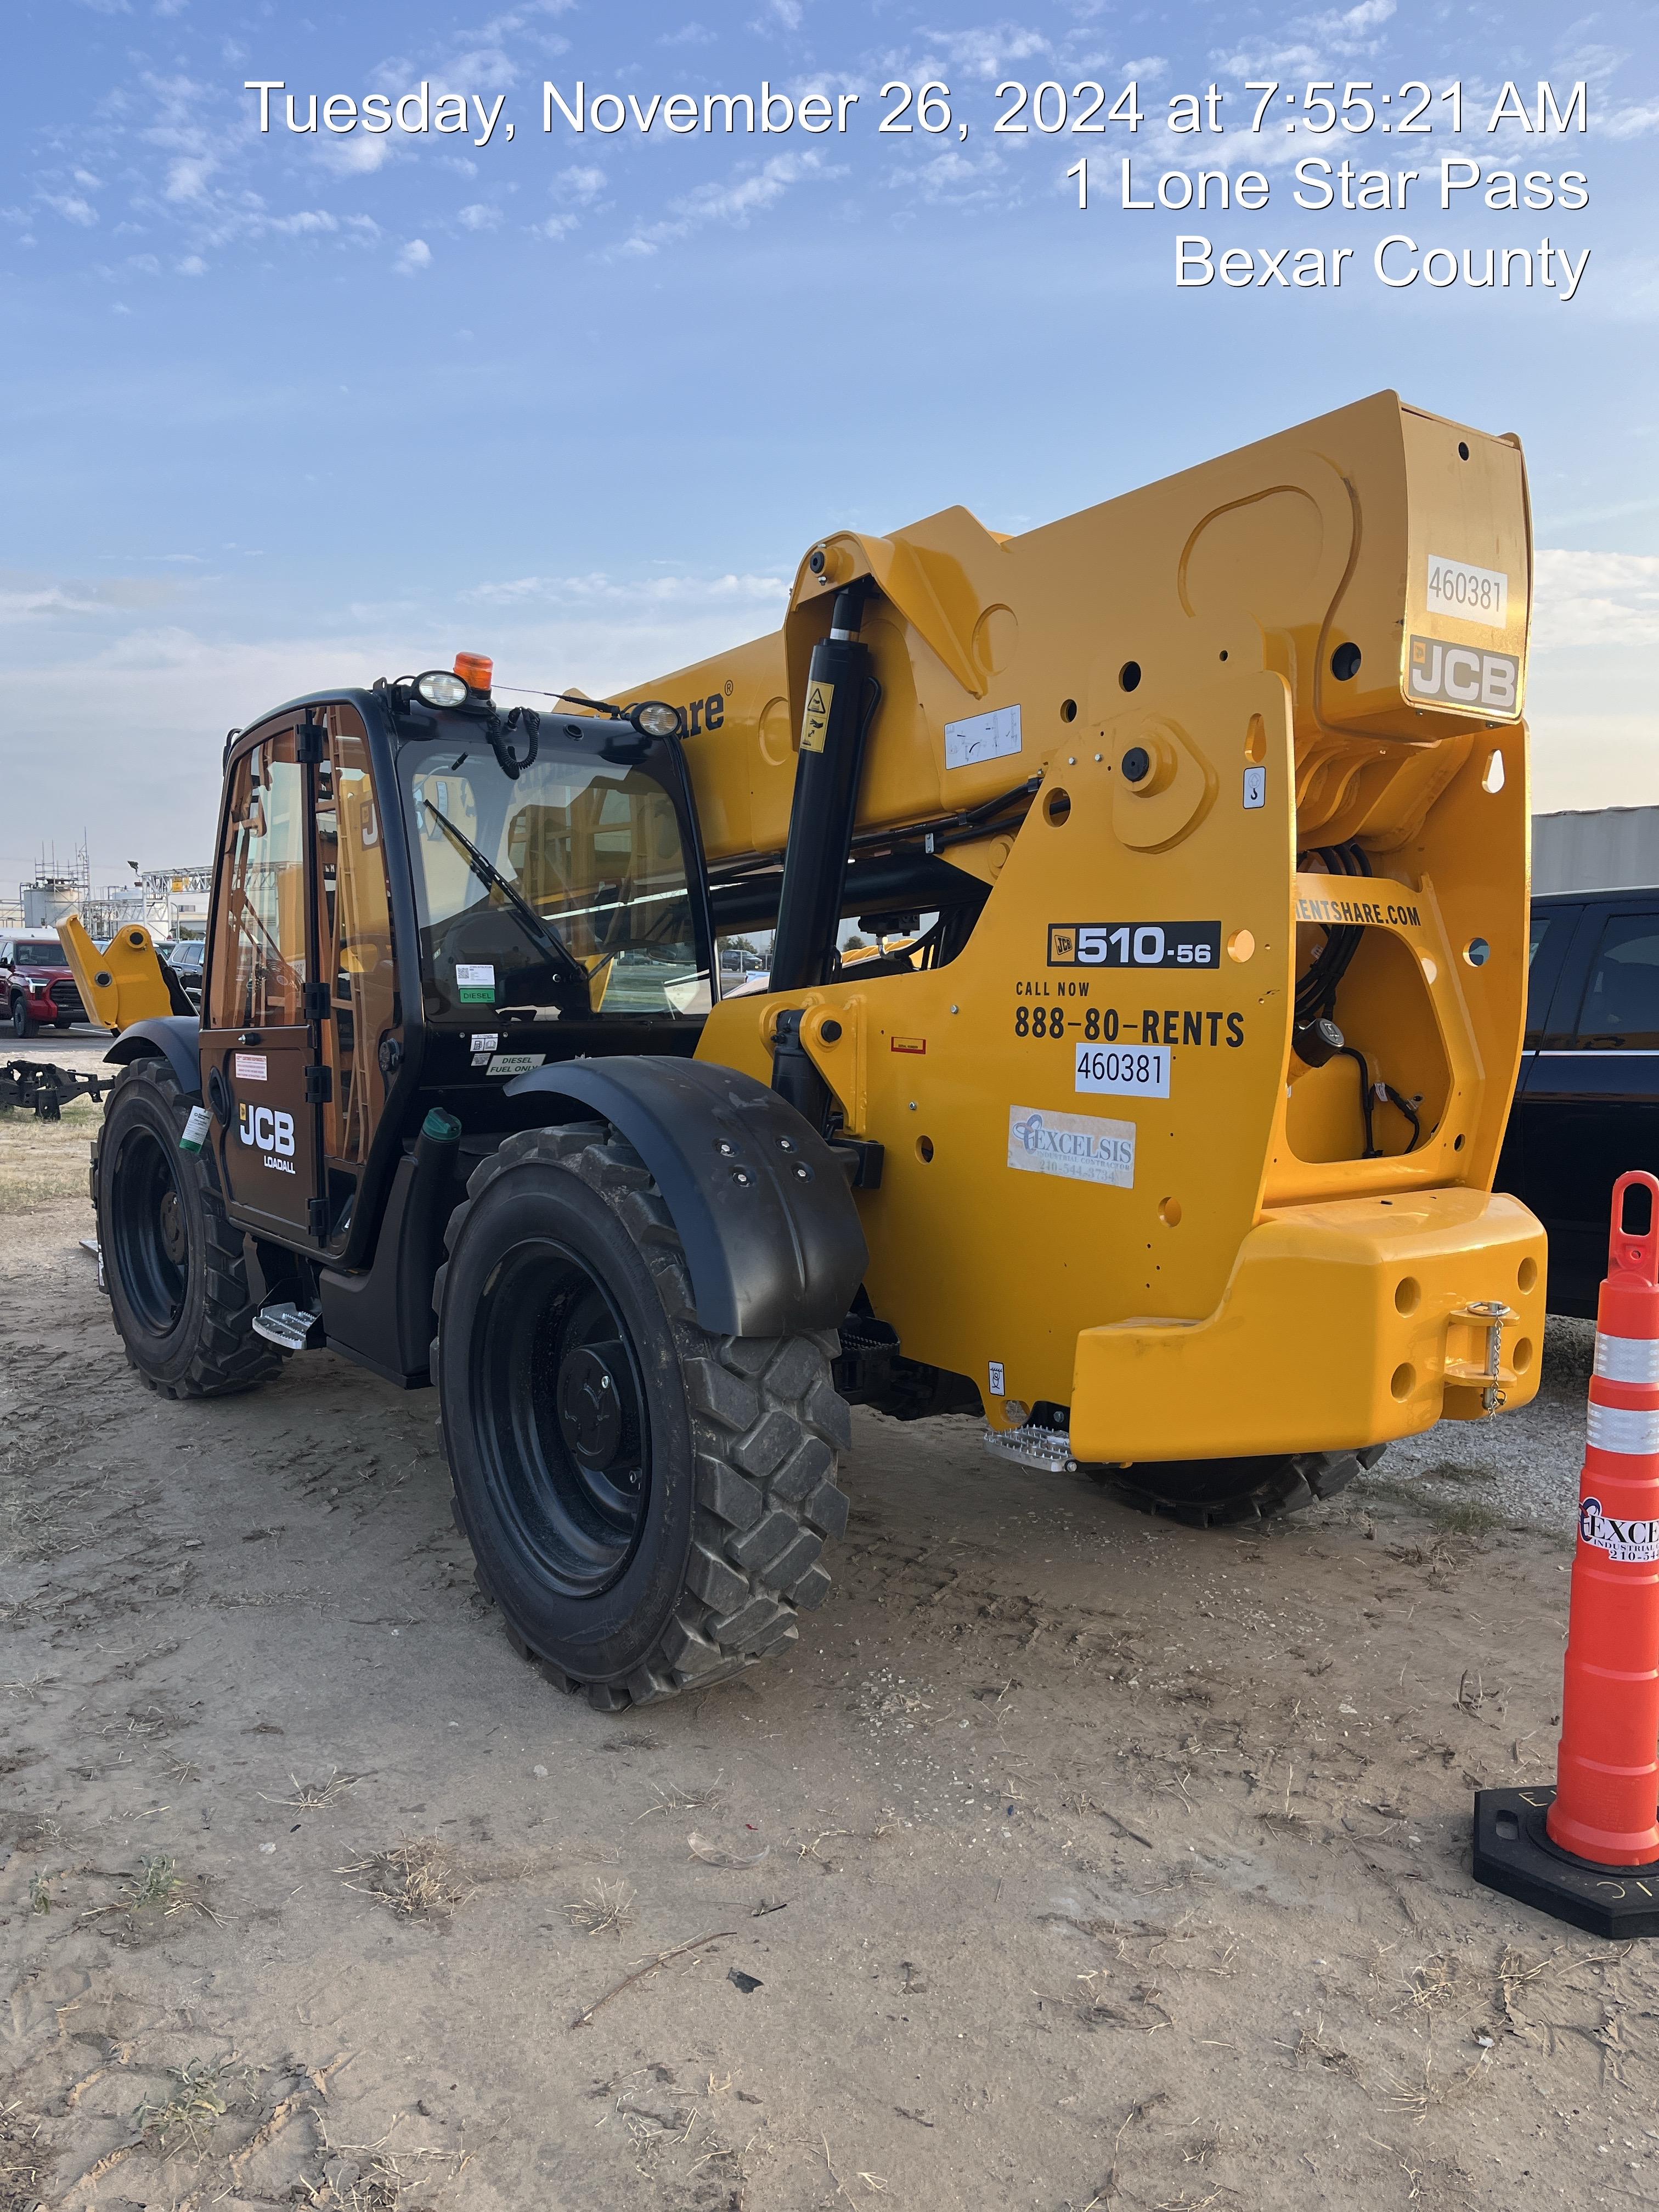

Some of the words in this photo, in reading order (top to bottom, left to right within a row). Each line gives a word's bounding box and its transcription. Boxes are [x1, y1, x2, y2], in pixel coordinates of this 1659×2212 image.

[1429, 566, 1500, 612] 460381
[1412, 645, 1515, 707] JCB
[1057, 938, 1071, 953] JCB
[1015, 981, 1050, 996] CALL
[1058, 982, 1089, 997] NOW
[1015, 1006, 1244, 1048] 888-80-RENTS
[1077, 1052, 1161, 1084] 460381
[240, 1104, 295, 1156] JCB
[1034, 1129, 1132, 1163] EXCELSIS
[263, 1155, 296, 1175] LOADALL
[1037, 1150, 1079, 1162] INDUSTRIAL
[1080, 1158, 1130, 1171] CONTRACTOR
[1594, 1539, 1653, 1551] INDUSTRIAL
